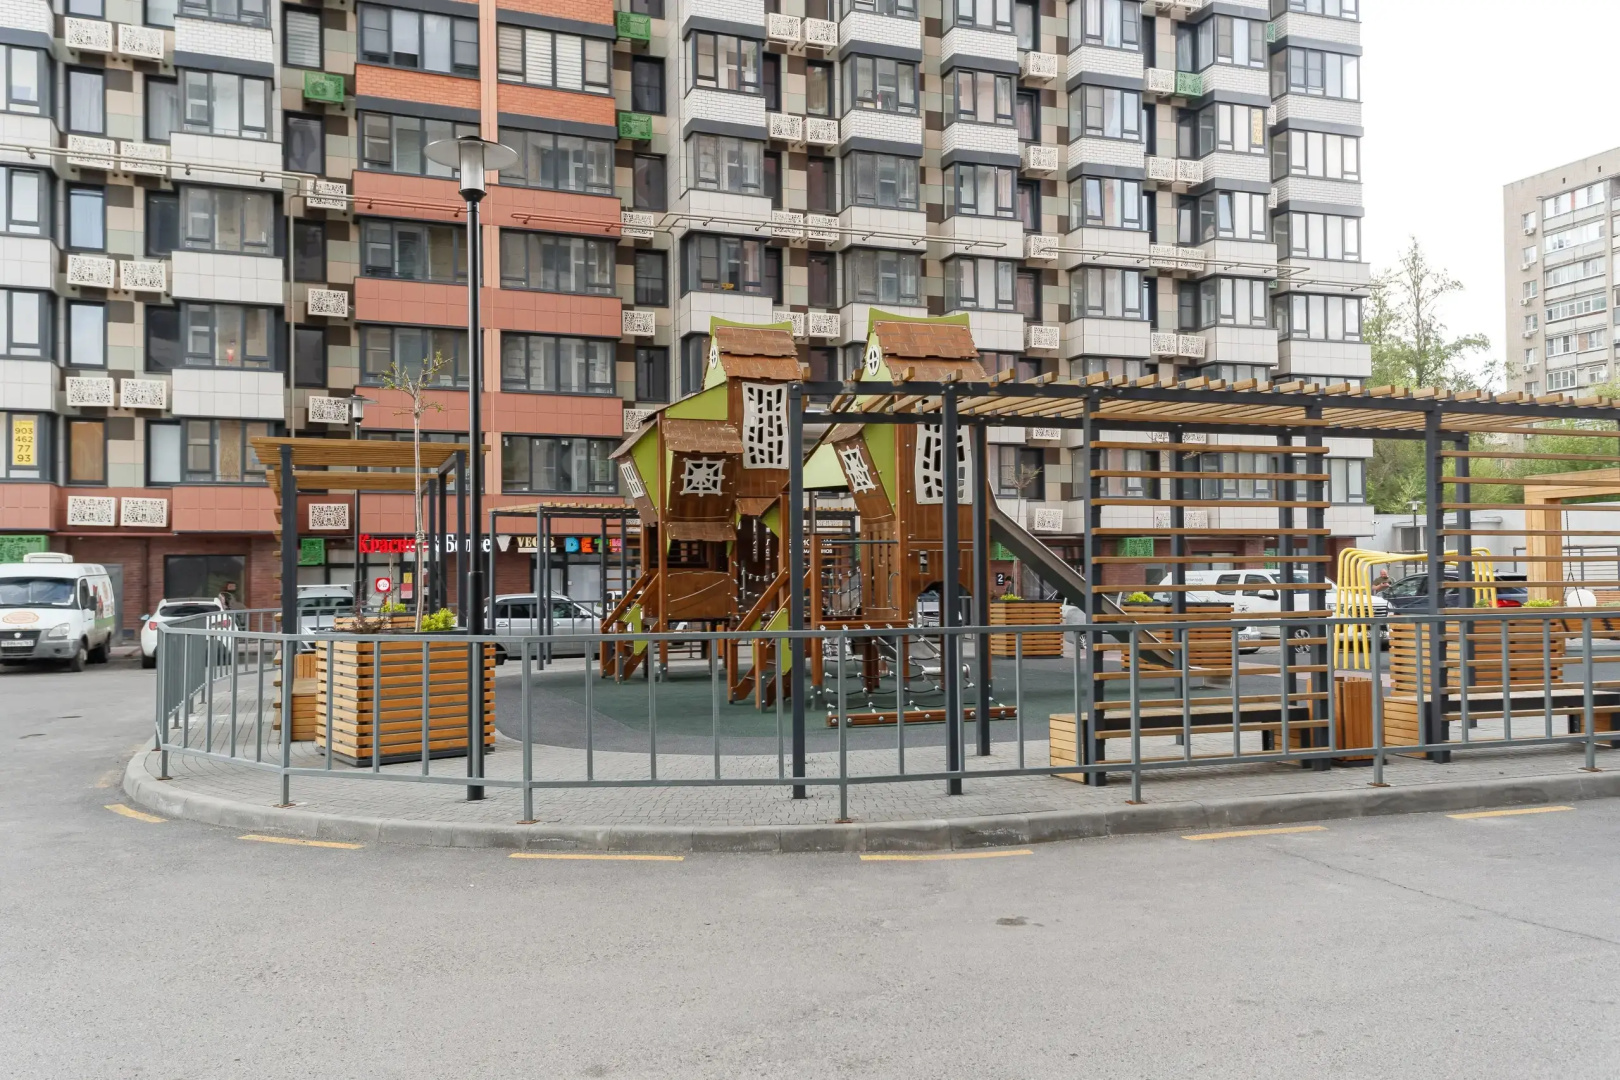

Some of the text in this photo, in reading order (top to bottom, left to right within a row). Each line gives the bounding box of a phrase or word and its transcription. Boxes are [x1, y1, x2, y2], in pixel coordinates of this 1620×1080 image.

[14, 427, 33, 435] 903
[17, 444, 31, 453] 77
[17, 454, 31, 463] 93
[446, 534, 491, 553] Бле
[516, 536, 555, 548] VEGS
[997, 573, 1004, 583] 2
